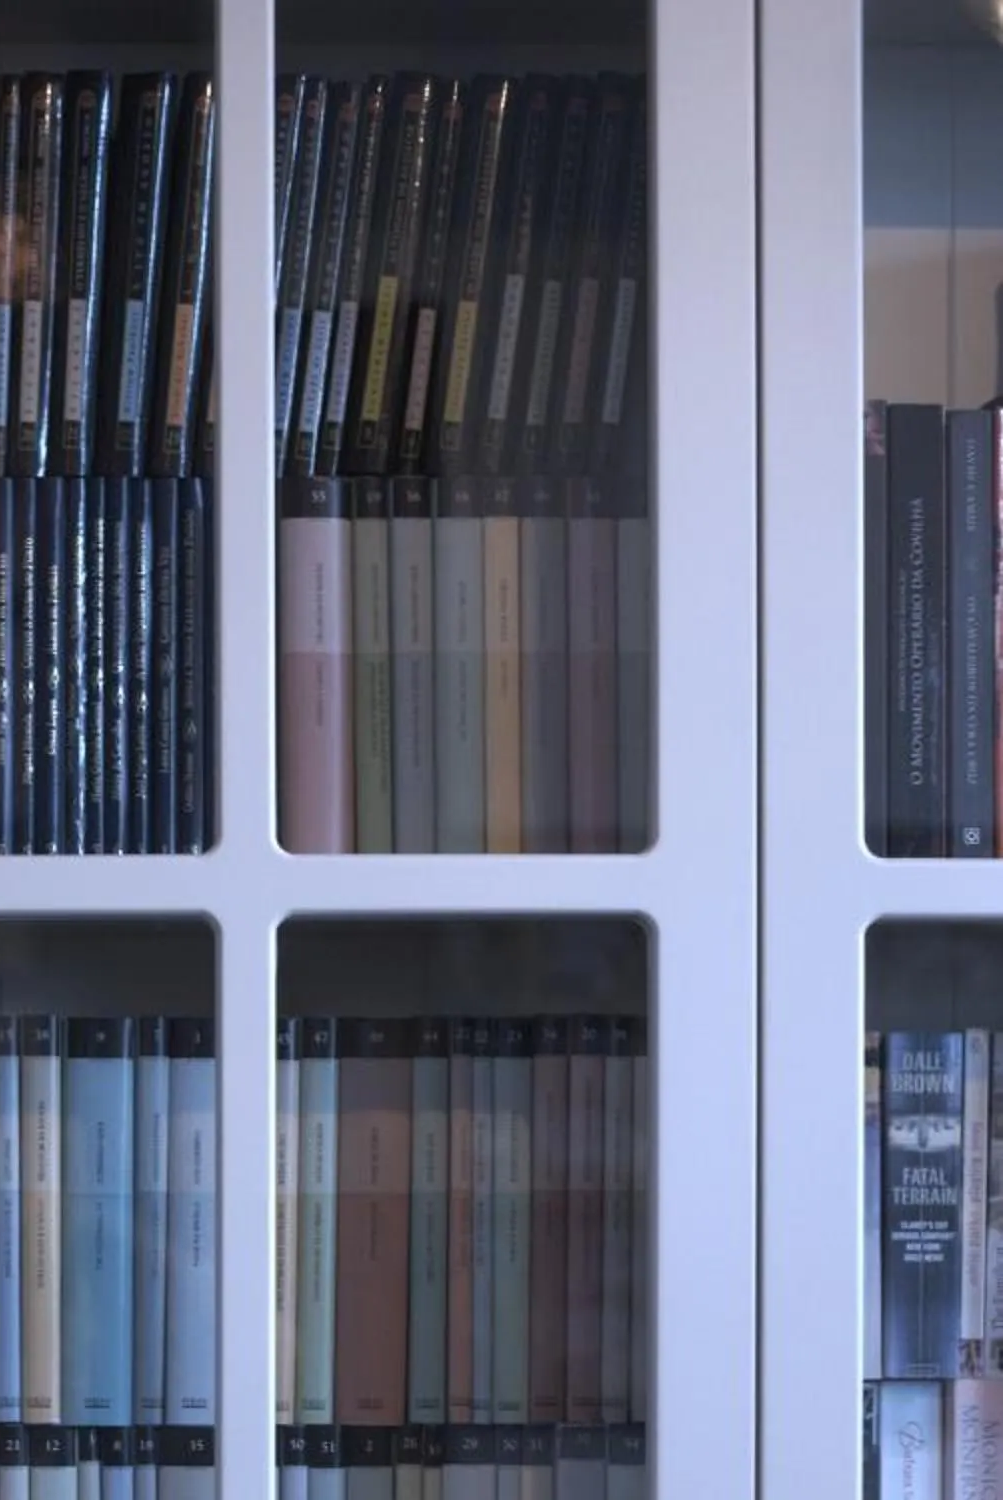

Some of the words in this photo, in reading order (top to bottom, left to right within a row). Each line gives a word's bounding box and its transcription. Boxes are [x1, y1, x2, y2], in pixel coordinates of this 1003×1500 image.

[909, 672, 924, 767] MOVIMENTO
[902, 1050, 944, 1071] DALE
[891, 1073, 955, 1094] BROWN
[902, 1167, 947, 1187] FATAL
[892, 1187, 958, 1206] TERRAIN
